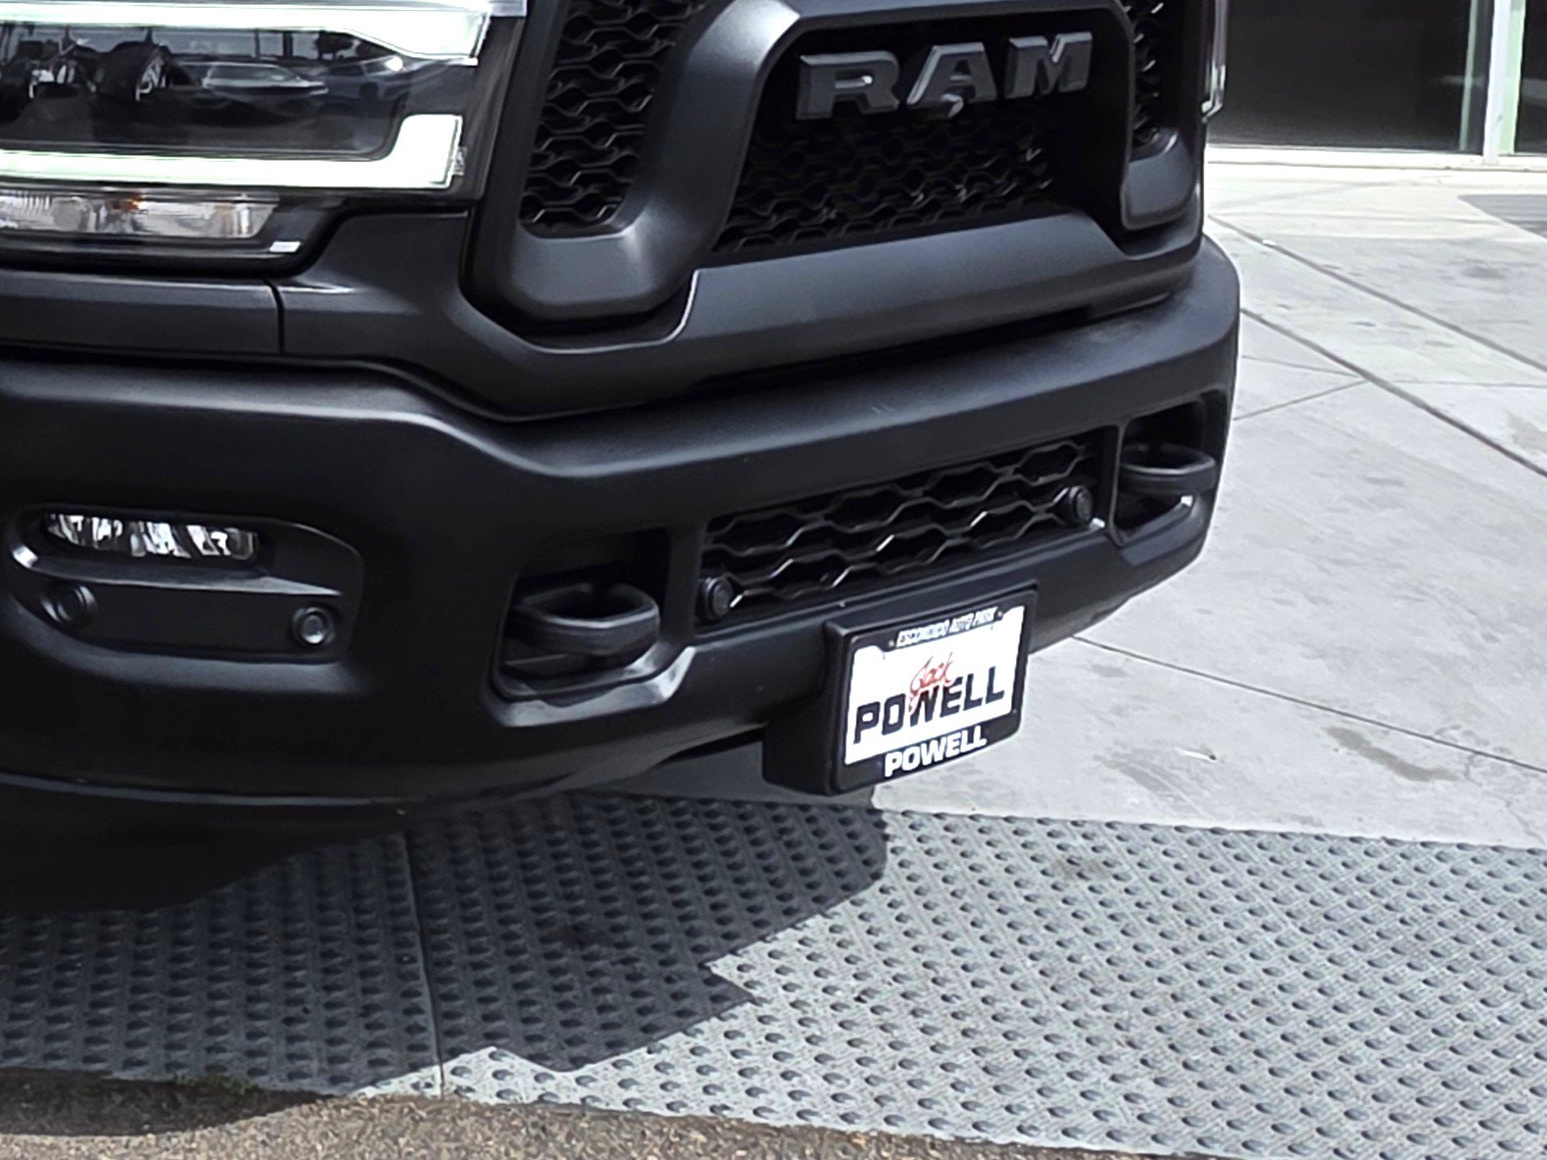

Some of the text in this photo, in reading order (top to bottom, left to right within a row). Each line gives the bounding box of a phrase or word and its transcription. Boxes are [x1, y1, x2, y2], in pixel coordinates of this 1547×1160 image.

[796, 31, 1093, 120] RAM
[853, 666, 1005, 745] POWELL
[885, 726, 987, 778] POWELL
